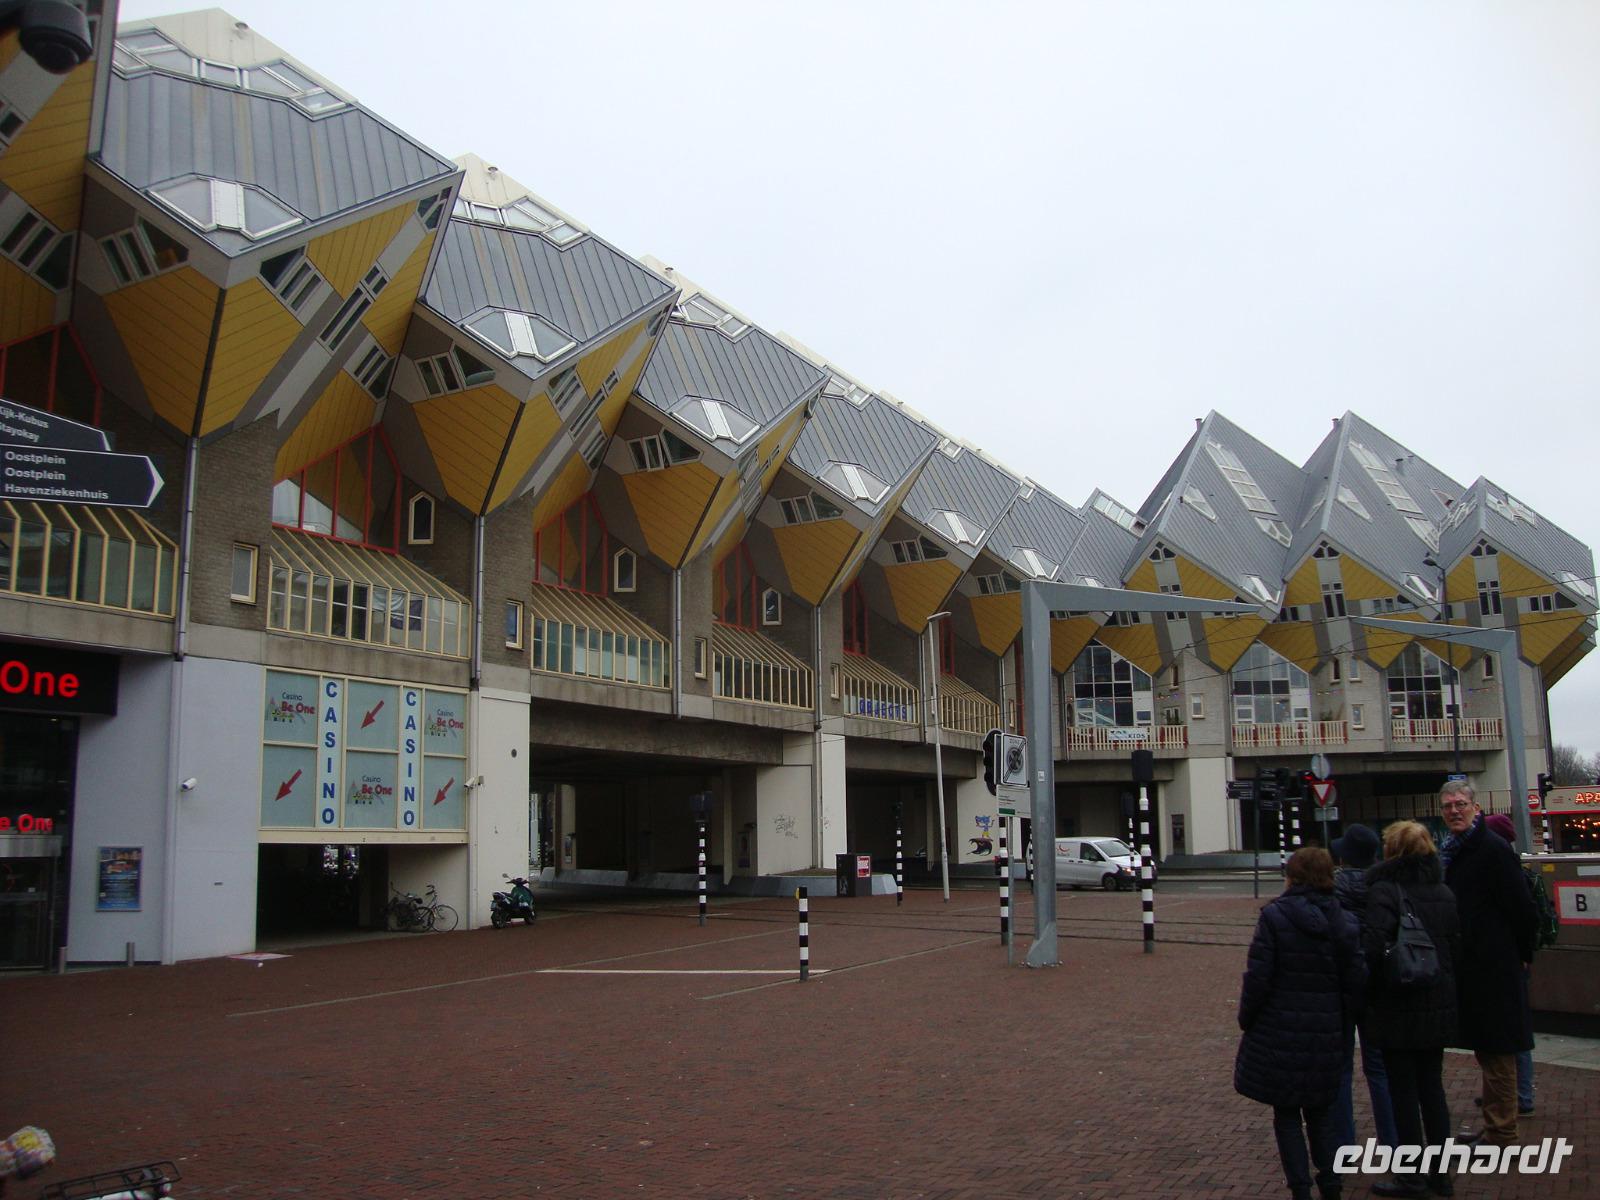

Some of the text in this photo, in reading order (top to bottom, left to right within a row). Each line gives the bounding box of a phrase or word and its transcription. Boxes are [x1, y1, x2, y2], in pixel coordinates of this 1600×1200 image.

[5, 451, 66, 465] Oostplein
[5, 467, 66, 481] Oostplein
[5, 484, 109, 500] Havenziekenhuis
[0, 660, 80, 698] One
[282, 691, 303, 701] Casino
[281, 701, 315, 715] Be One
[437, 708, 454, 717] Casino
[437, 716, 464, 730] Be One
[322, 681, 338, 825] CASINO
[403, 691, 417, 826] CASINO
[362, 774, 381, 783] Casino
[361, 783, 392, 795] Be One
[0, 813, 53, 833] e One
[1575, 893, 1588, 912] B
